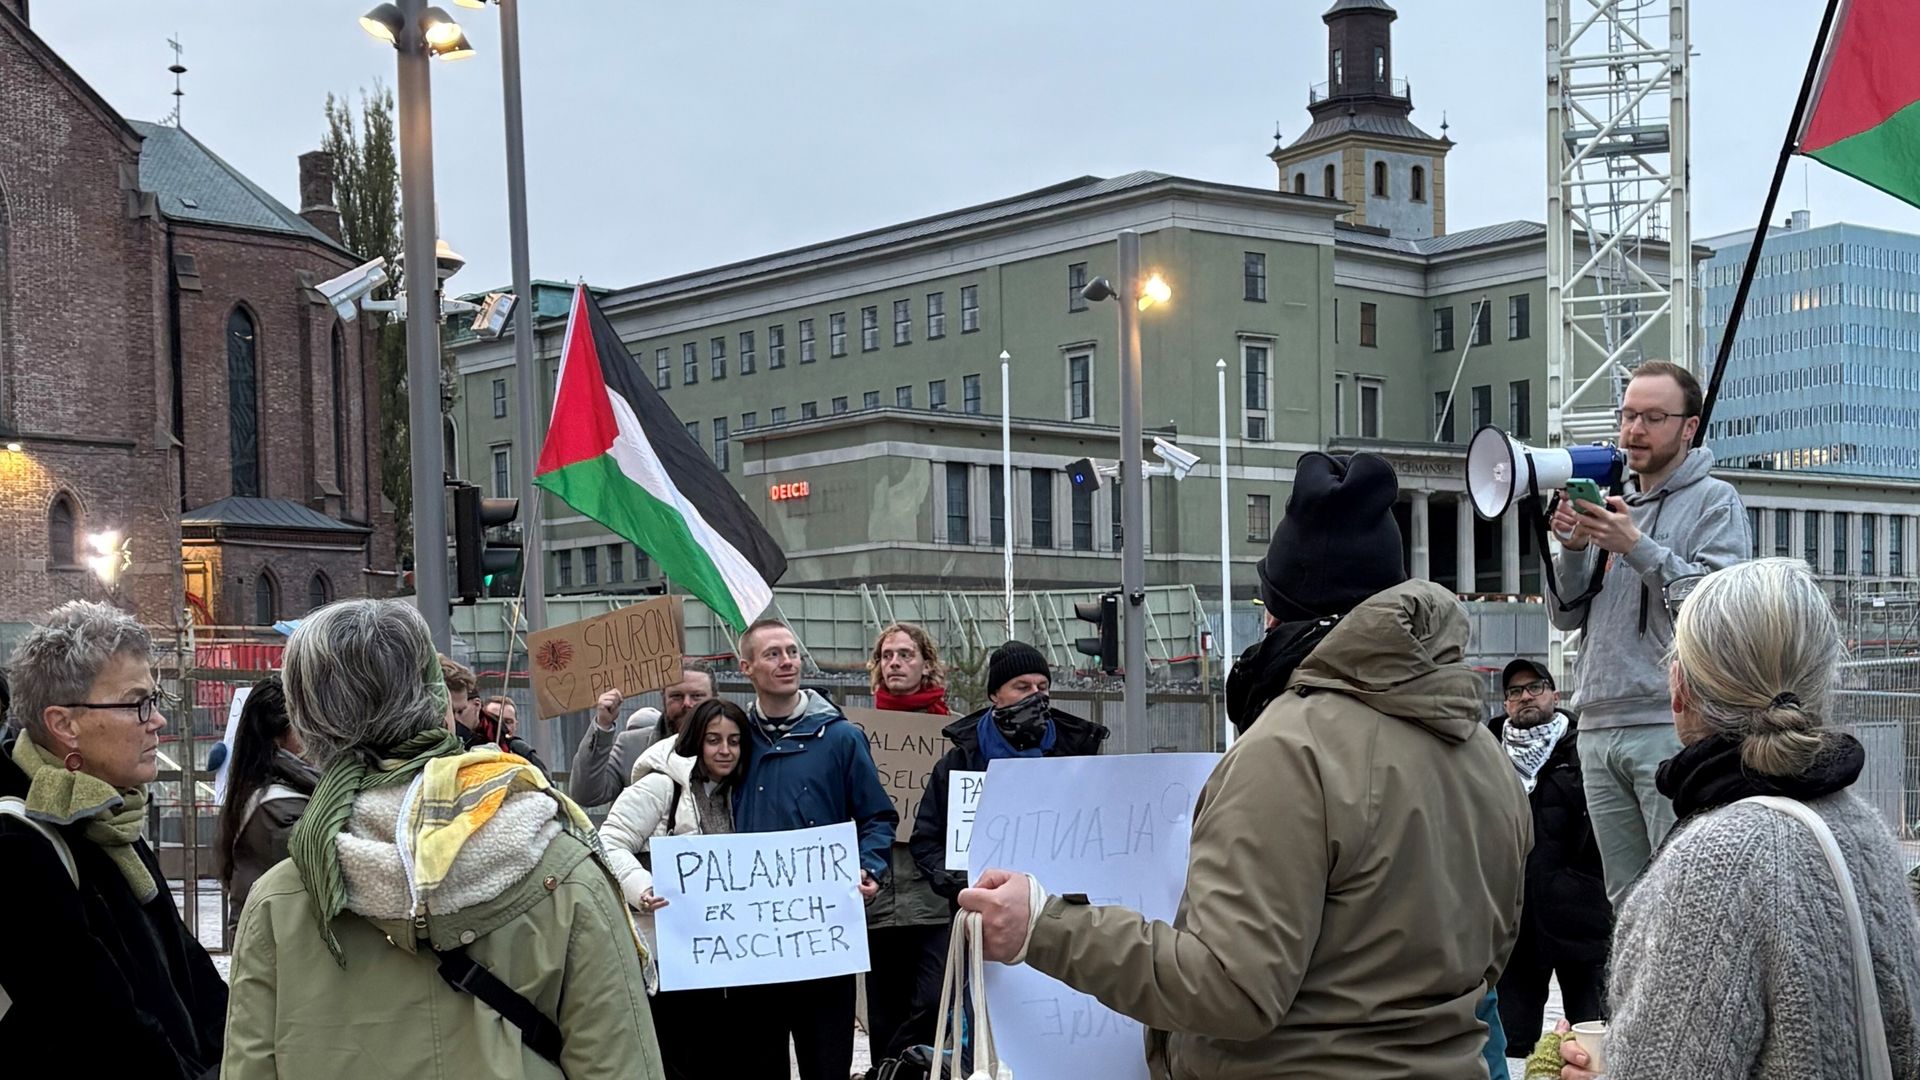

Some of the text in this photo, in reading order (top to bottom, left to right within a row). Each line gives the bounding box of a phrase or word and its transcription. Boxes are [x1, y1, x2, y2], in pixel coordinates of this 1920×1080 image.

[770, 481, 810, 500] DEICH
[584, 604, 675, 669] SAURON
[705, 896, 836, 923] ER TECH-
